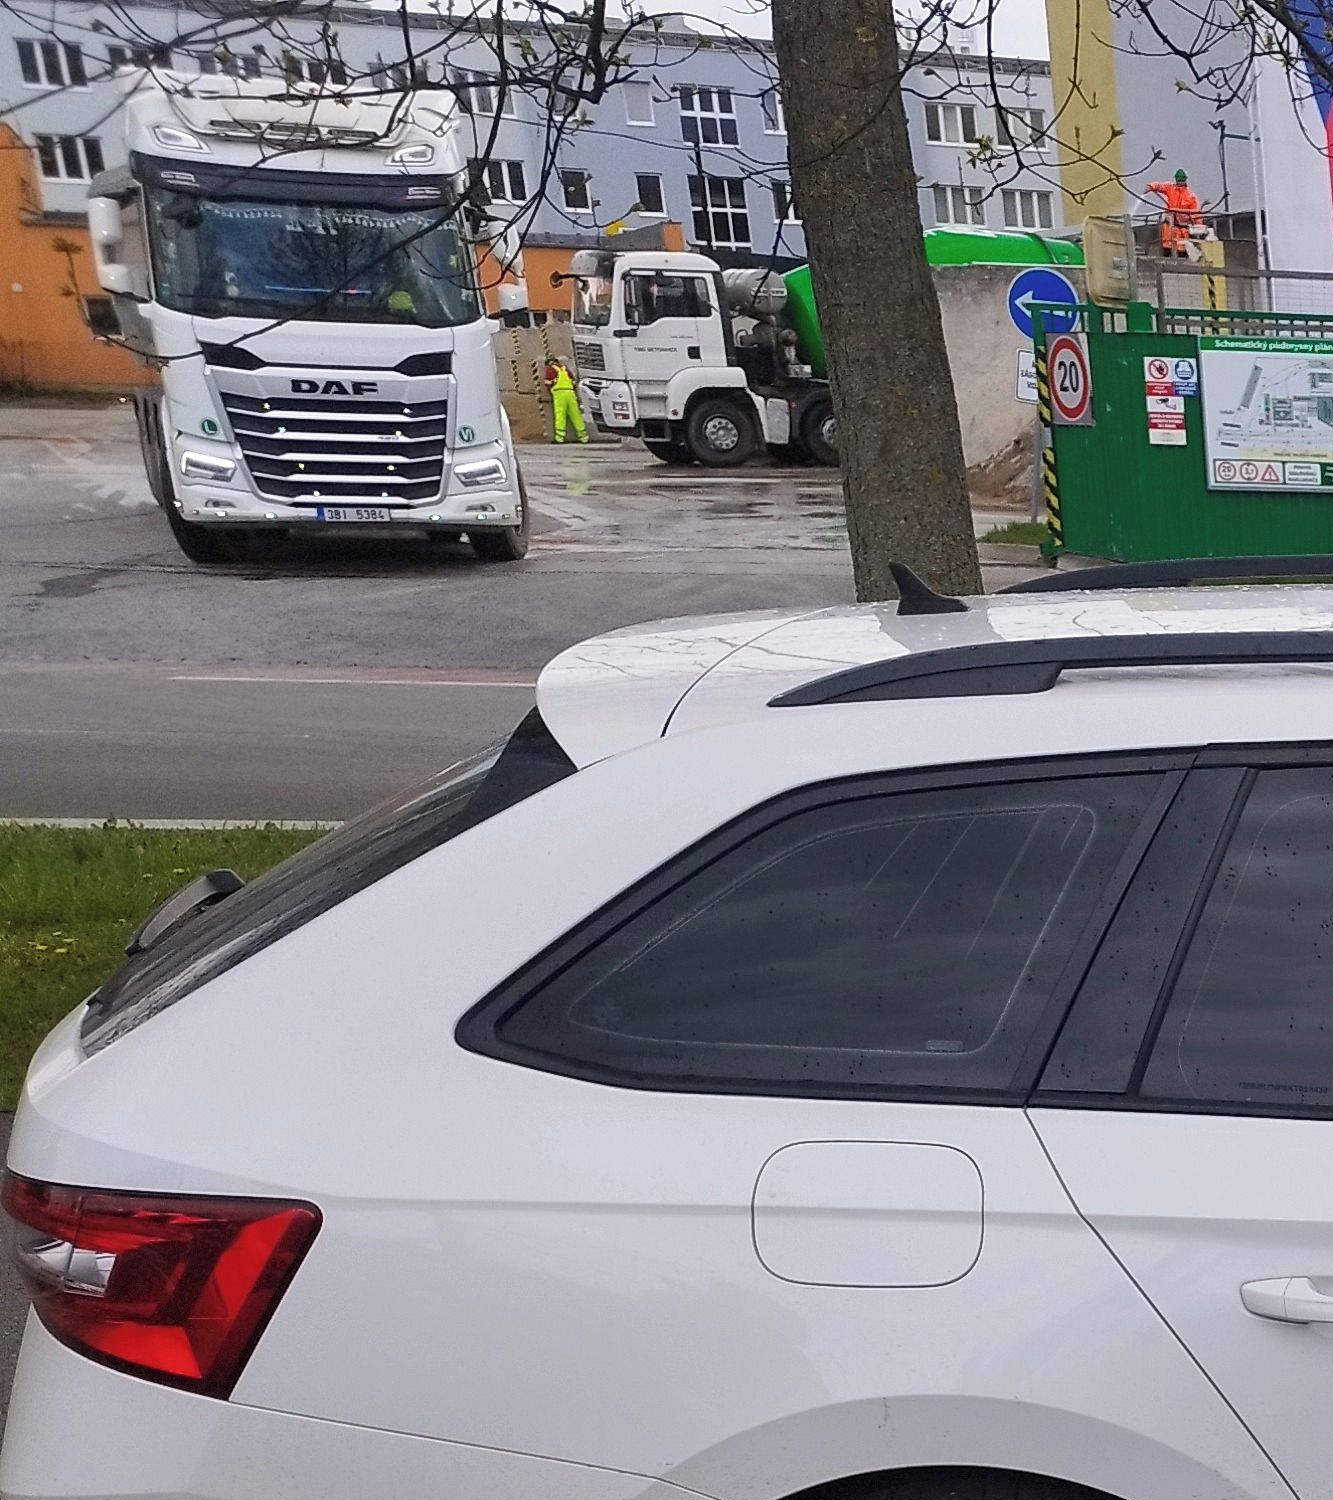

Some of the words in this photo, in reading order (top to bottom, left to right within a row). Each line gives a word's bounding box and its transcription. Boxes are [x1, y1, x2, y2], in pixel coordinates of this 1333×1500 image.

[1058, 361, 1079, 393] 20
[290, 379, 379, 396] DAF
[355, 509, 385, 520] 5384
